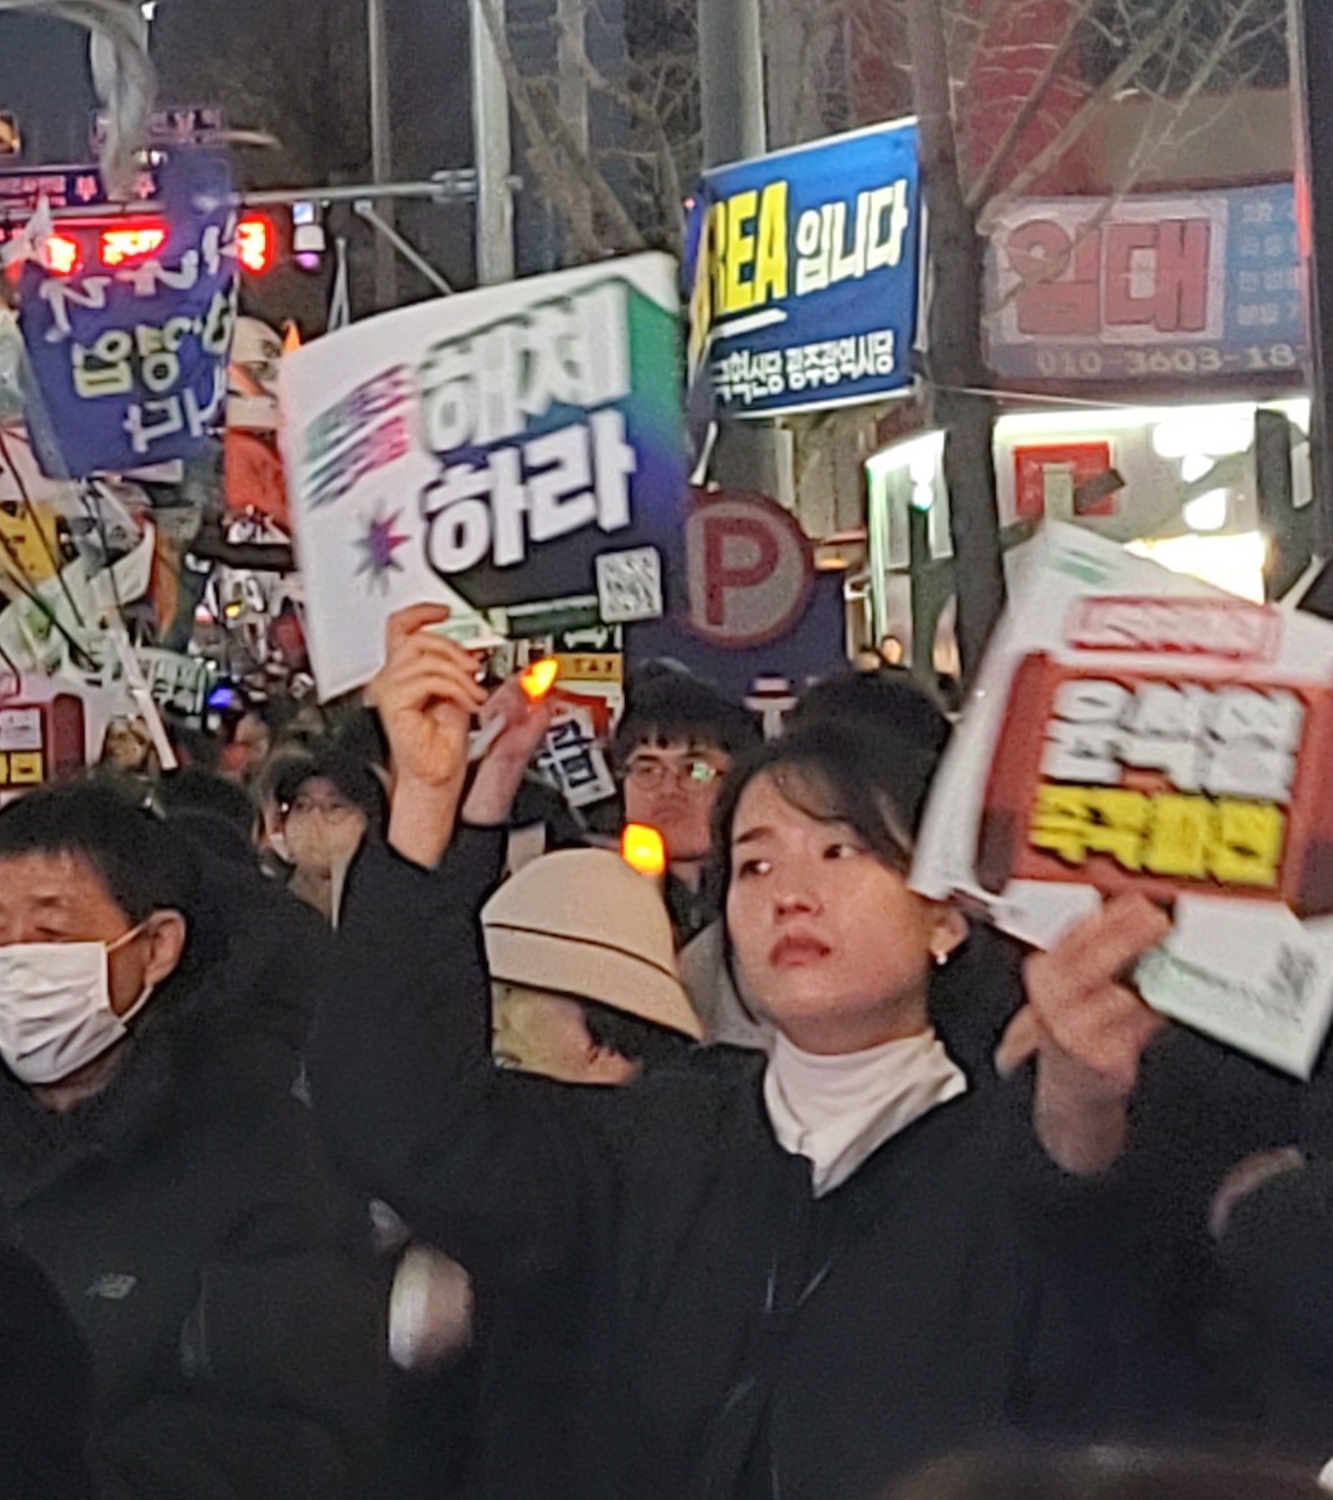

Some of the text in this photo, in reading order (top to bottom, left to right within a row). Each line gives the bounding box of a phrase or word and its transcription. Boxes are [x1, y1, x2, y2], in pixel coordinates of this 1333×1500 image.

[795, 179, 909, 297] 입니다
[1005, 217, 1211, 336] 임대
[1036, 342, 1305, 376] 010-3603-18
[427, 409, 638, 575] 하라
[704, 516, 779, 626] P
